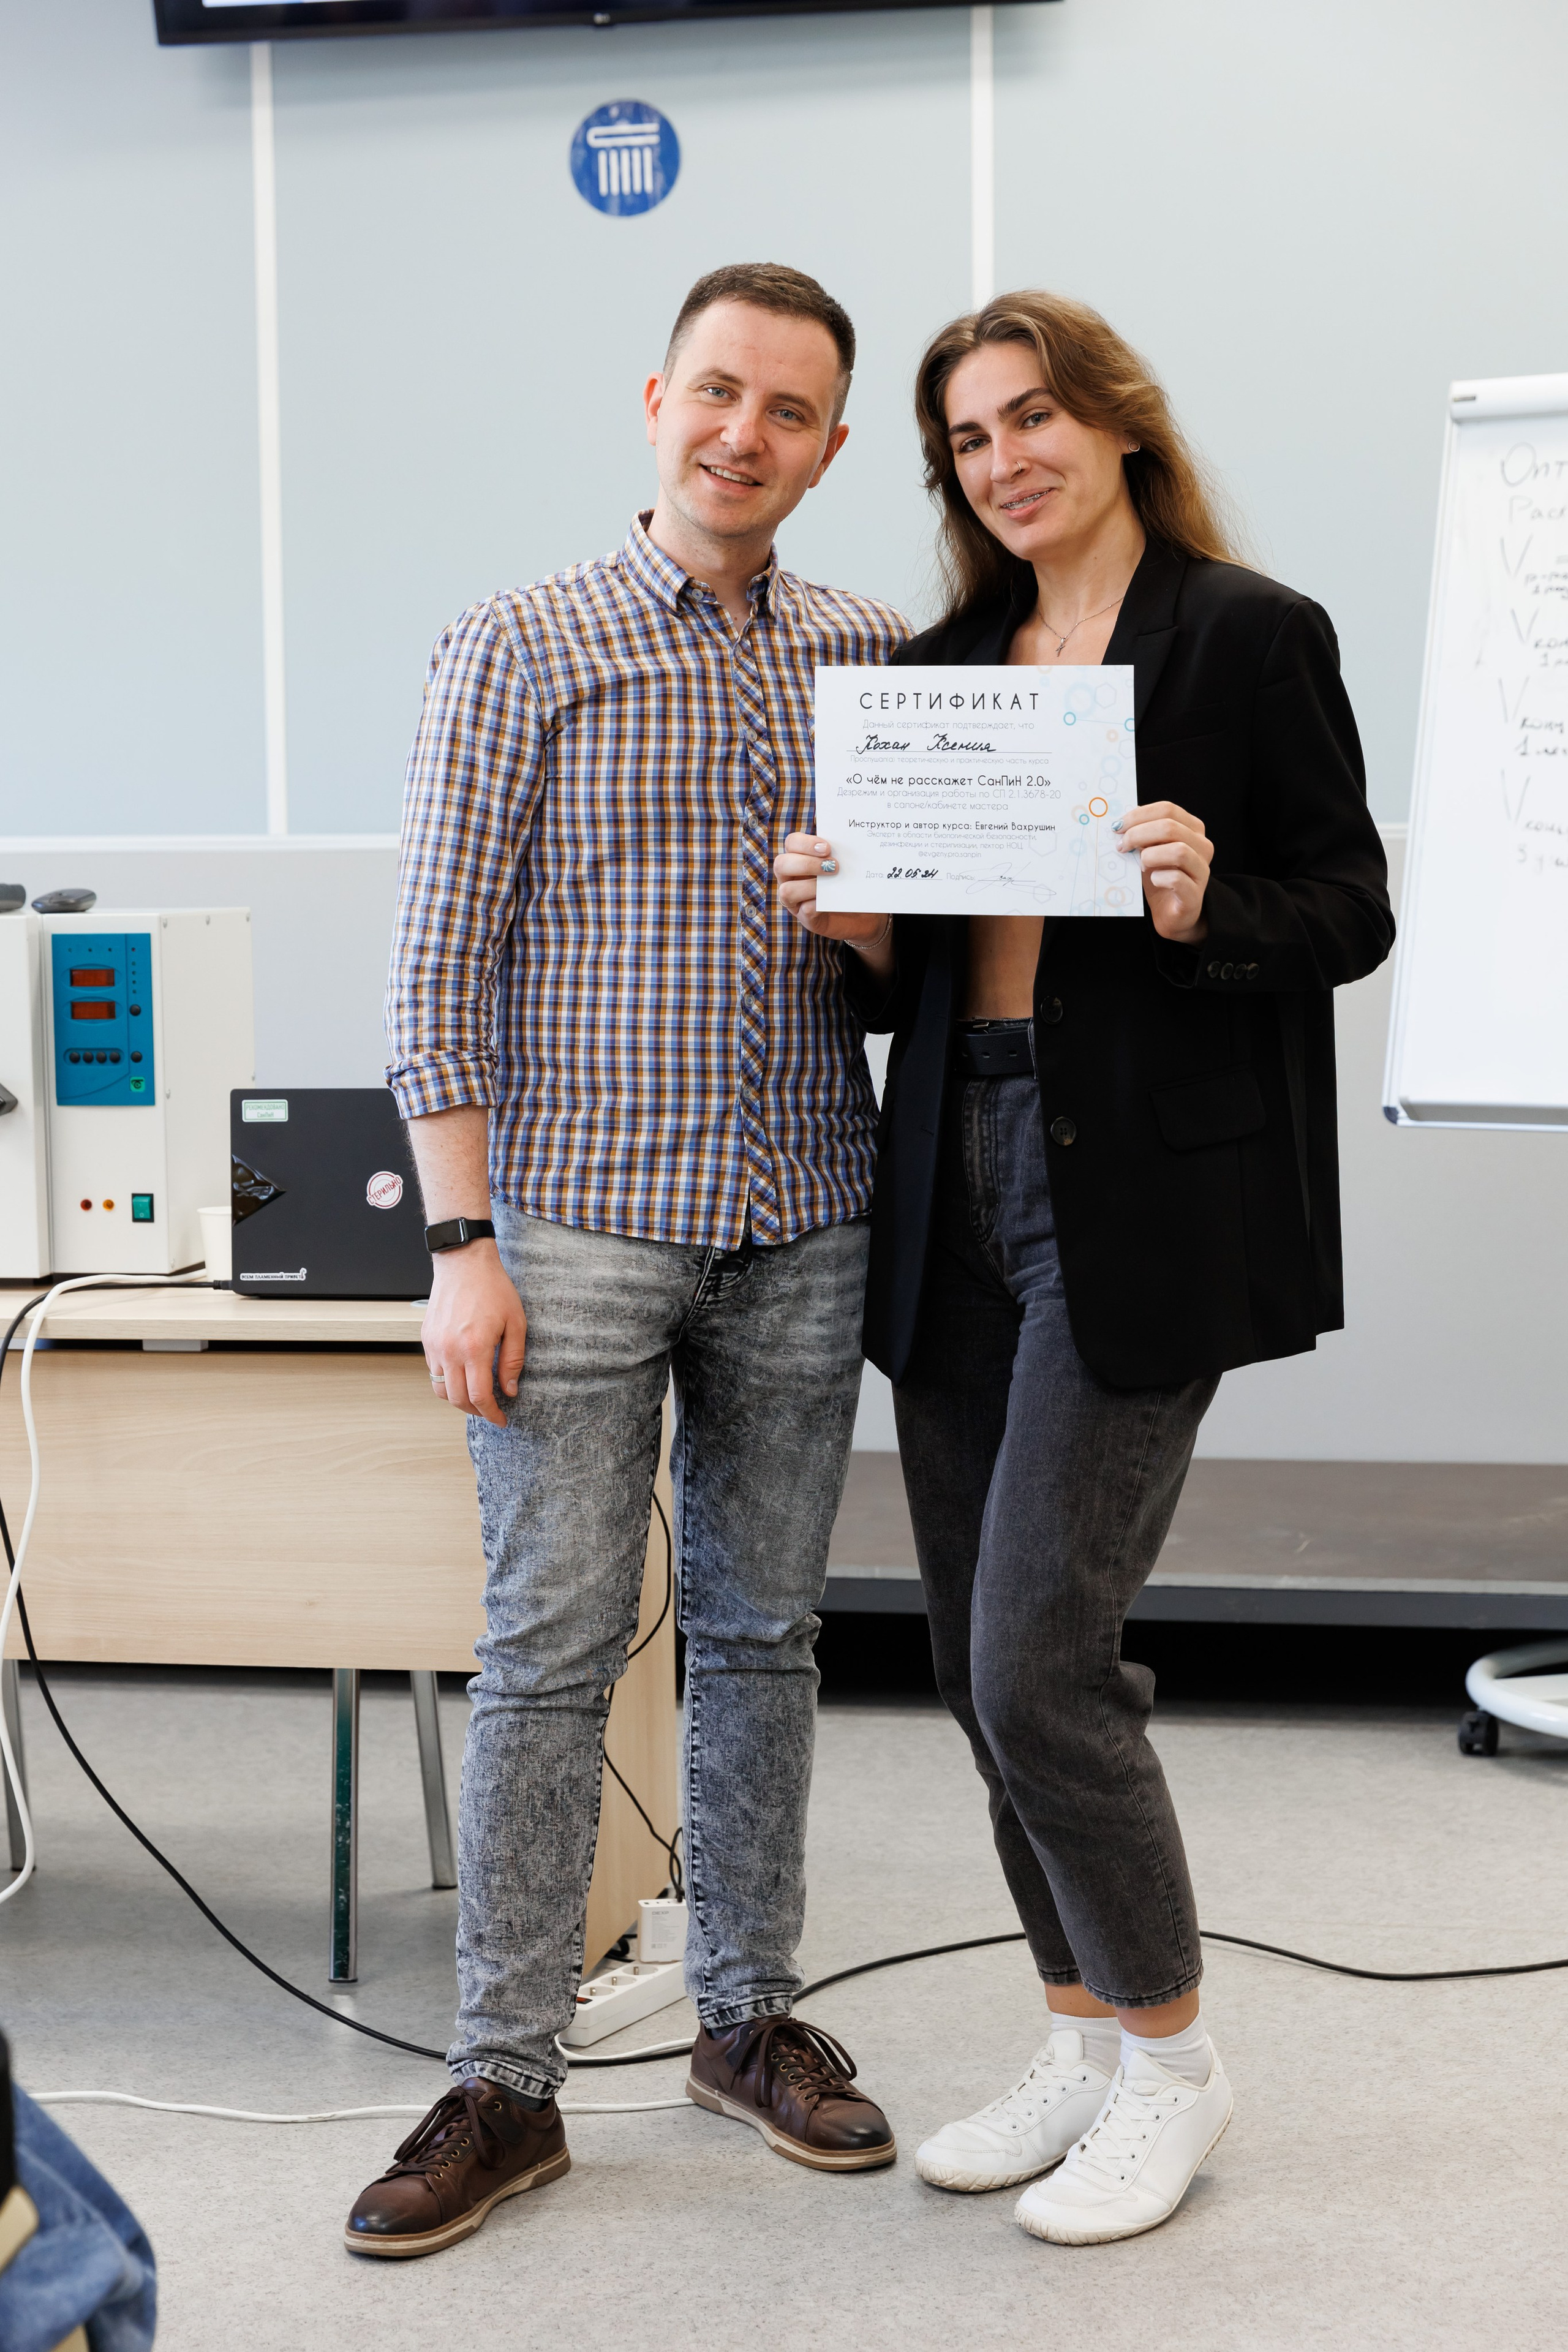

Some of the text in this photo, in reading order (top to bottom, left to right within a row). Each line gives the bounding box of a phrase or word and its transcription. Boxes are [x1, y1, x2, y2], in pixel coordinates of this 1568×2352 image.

[860, 692, 1038, 710] СЕРТИФИКАТ
[863, 720, 894, 729] Данный
[897, 721, 949, 730] сертификат
[953, 722, 1016, 730] подтверждает,
[927, 733, 997, 752] Ксения
[846, 773, 862, 784] «О
[867, 775, 887, 785] чём
[908, 777, 973, 786] расскажет
[978, 775, 1022, 786] СанПиН
[1027, 775, 1051, 786] 2.0»
[837, 787, 877, 797] Дезрежим
[888, 790, 939, 798] организация
[942, 789, 976, 798] работы
[993, 789, 1006, 798] СП
[1009, 790, 1061, 799] 2.1.3678-20
[894, 801, 967, 809] салоне/кабинете
[970, 803, 1008, 812] мастера
[848, 819, 902, 829] Инструктор
[913, 822, 939, 831] автор
[975, 821, 1008, 830] Евгений
[1011, 821, 1055, 832] Вахрушин
[368, 1177, 402, 1204] СТЕРИЛЬНО
